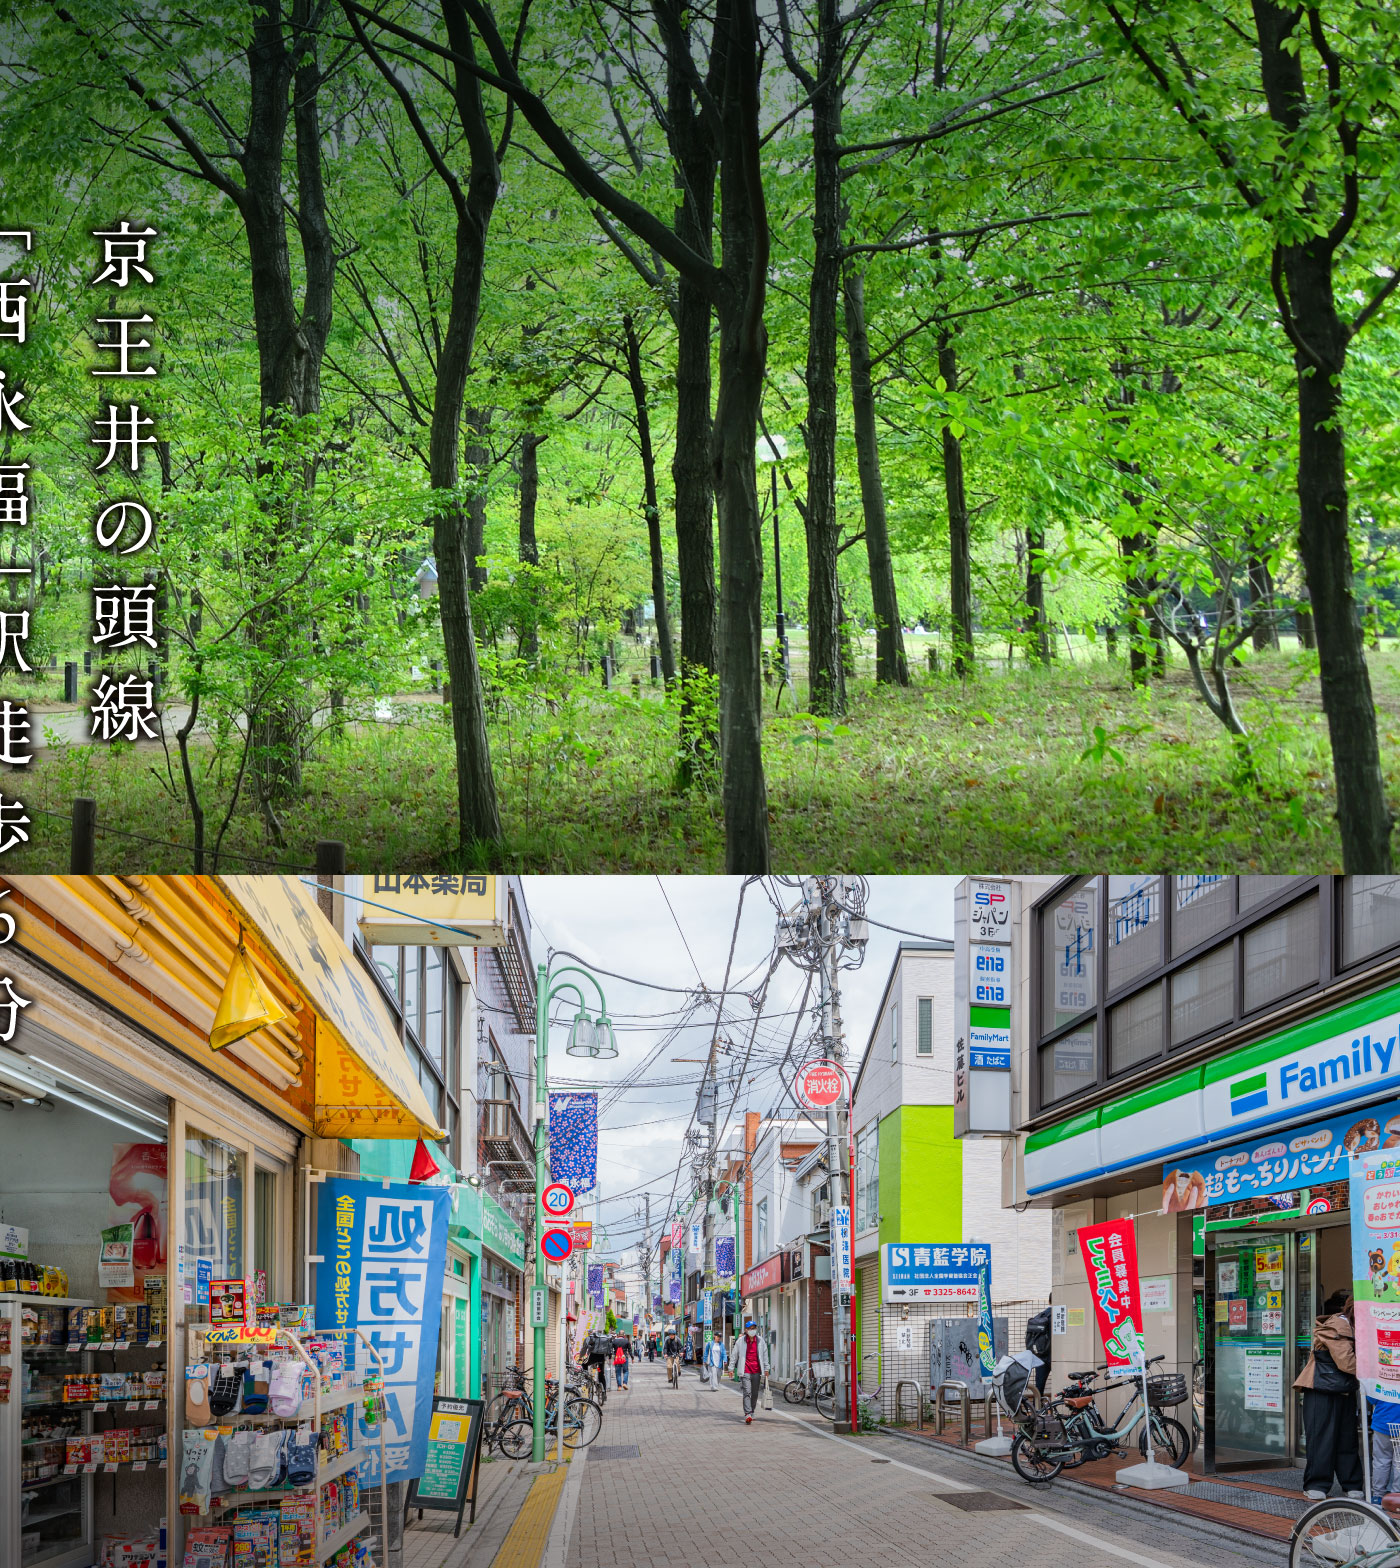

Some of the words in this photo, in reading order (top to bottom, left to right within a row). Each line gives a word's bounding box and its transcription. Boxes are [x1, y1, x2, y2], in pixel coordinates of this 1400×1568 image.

[374, 875, 488, 897] 山本薬局
[978, 883, 1001, 891] 株式会社
[975, 892, 1006, 905] SP
[971, 907, 1009, 925] ジャパン
[976, 955, 1005, 972] ena
[976, 985, 1005, 1002] ena
[970, 1031, 1009, 1043] FamilyMart
[974, 1054, 984, 1065] 酒
[986, 1056, 1006, 1066] たばこ
[1280, 1024, 1400, 1099] Family
[956, 1037, 965, 1105] 佐藤ビル
[806, 1079, 840, 1095] 消火栓
[549, 1192, 568, 1207] 20
[913, 1247, 988, 1267] 青藍学院
[908, 1288, 919, 1296] 3F
[932, 1287, 977, 1296] 3325-8642
[205, 1328, 239, 1342] くつした
